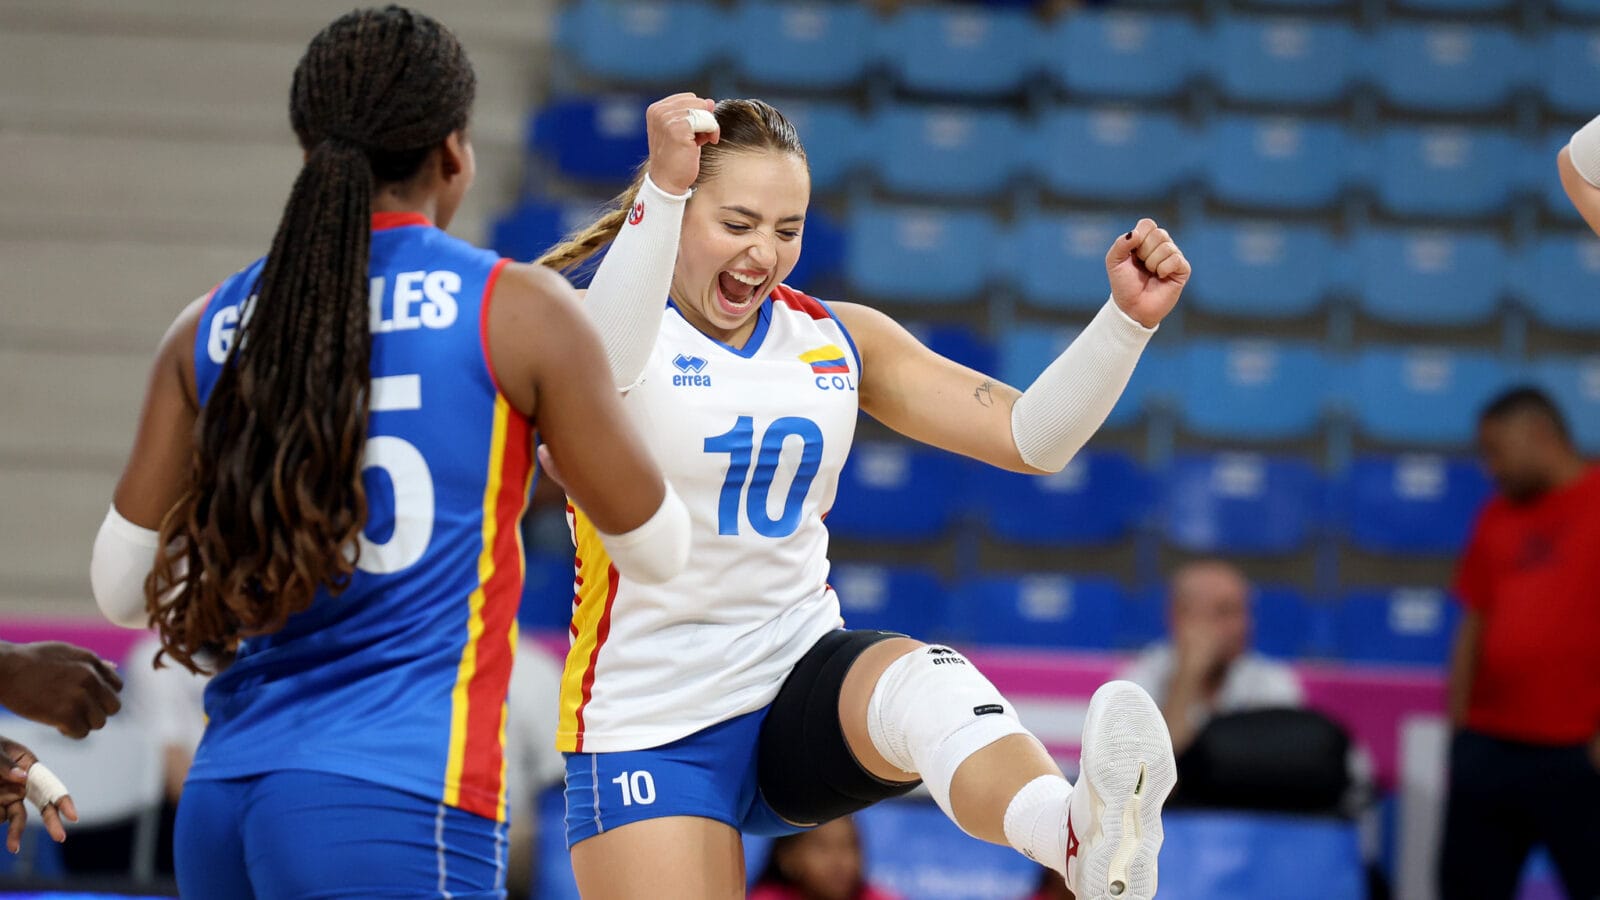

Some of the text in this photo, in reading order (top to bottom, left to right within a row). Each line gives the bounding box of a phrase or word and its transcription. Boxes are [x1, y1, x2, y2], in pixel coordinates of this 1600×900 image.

[815, 375, 855, 391] COL
[703, 415, 824, 538] 10
[612, 770, 656, 806] 10
